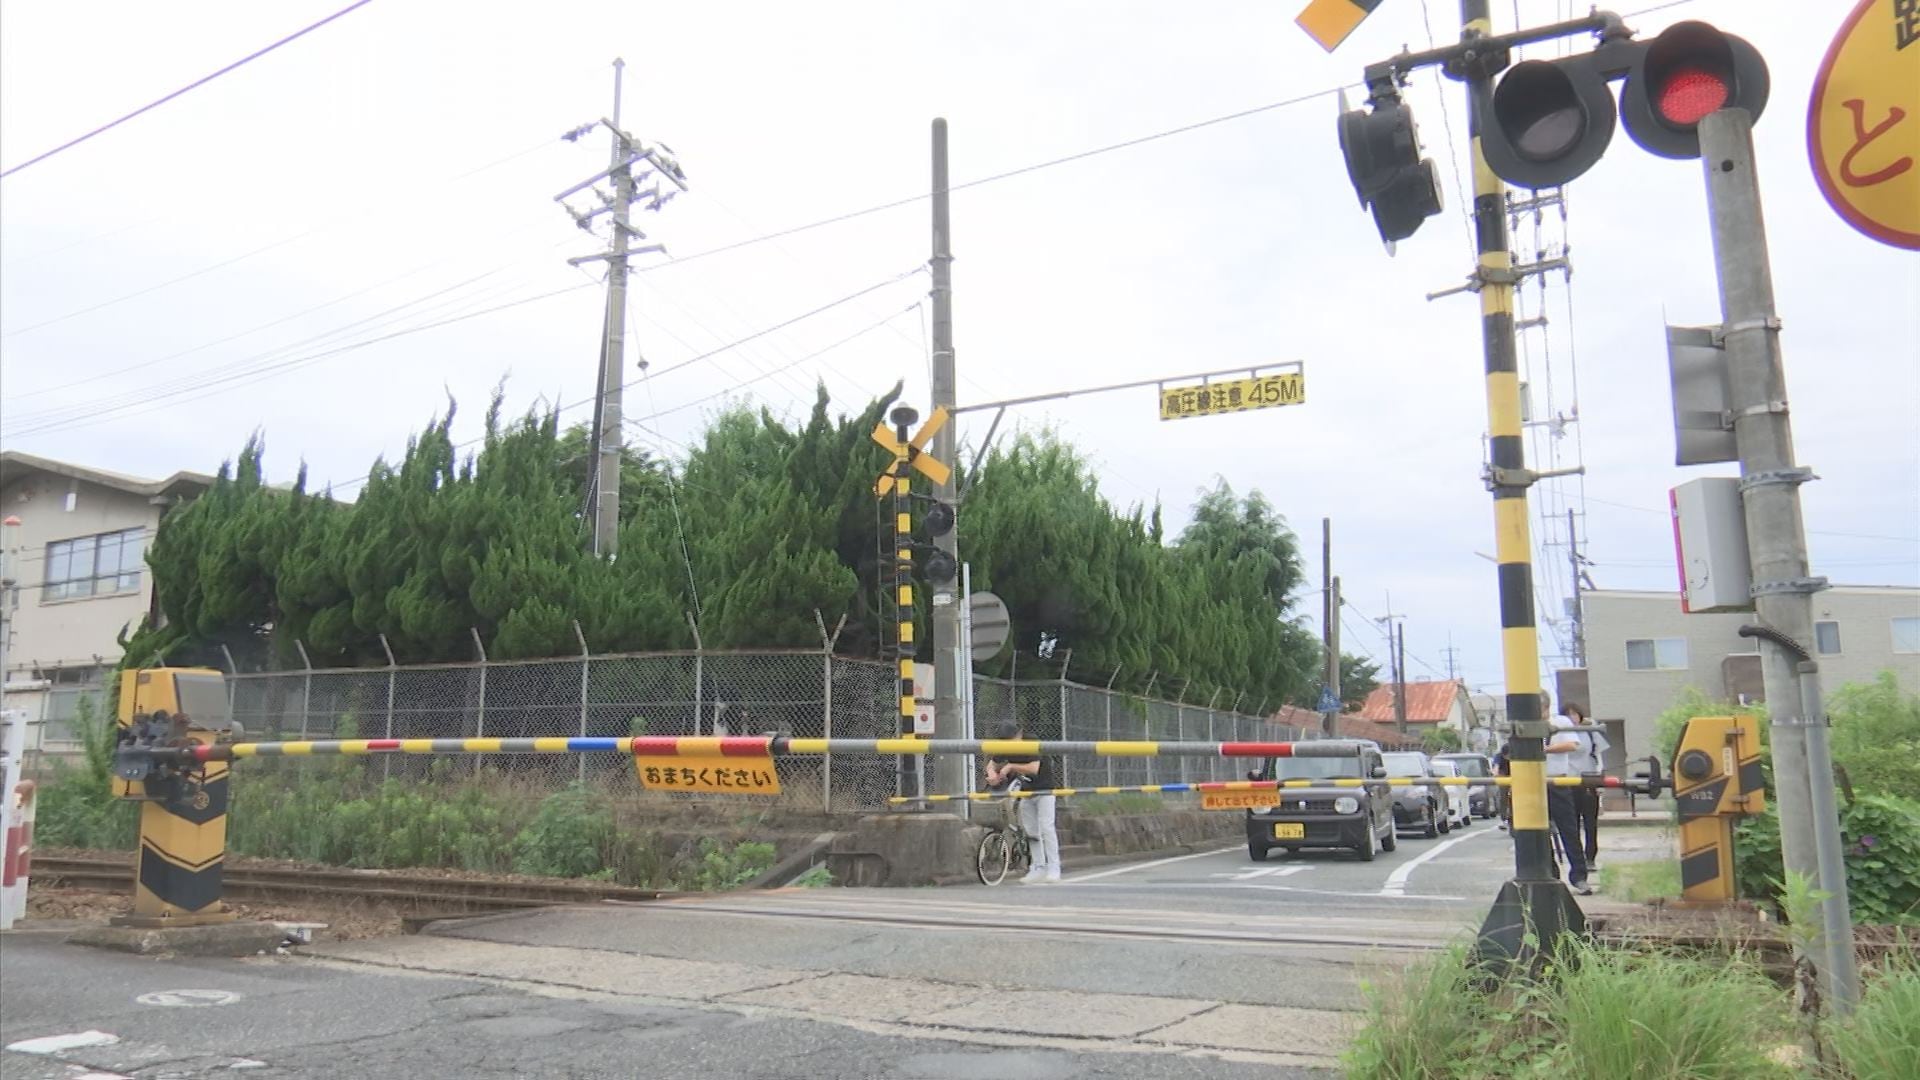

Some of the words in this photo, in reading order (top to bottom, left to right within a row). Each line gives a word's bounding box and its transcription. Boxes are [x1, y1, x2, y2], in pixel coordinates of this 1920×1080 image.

[1841, 99, 1913, 187] と
[1167, 386, 1242, 415] 高圧線注意
[645, 767, 772, 788] おまちください
